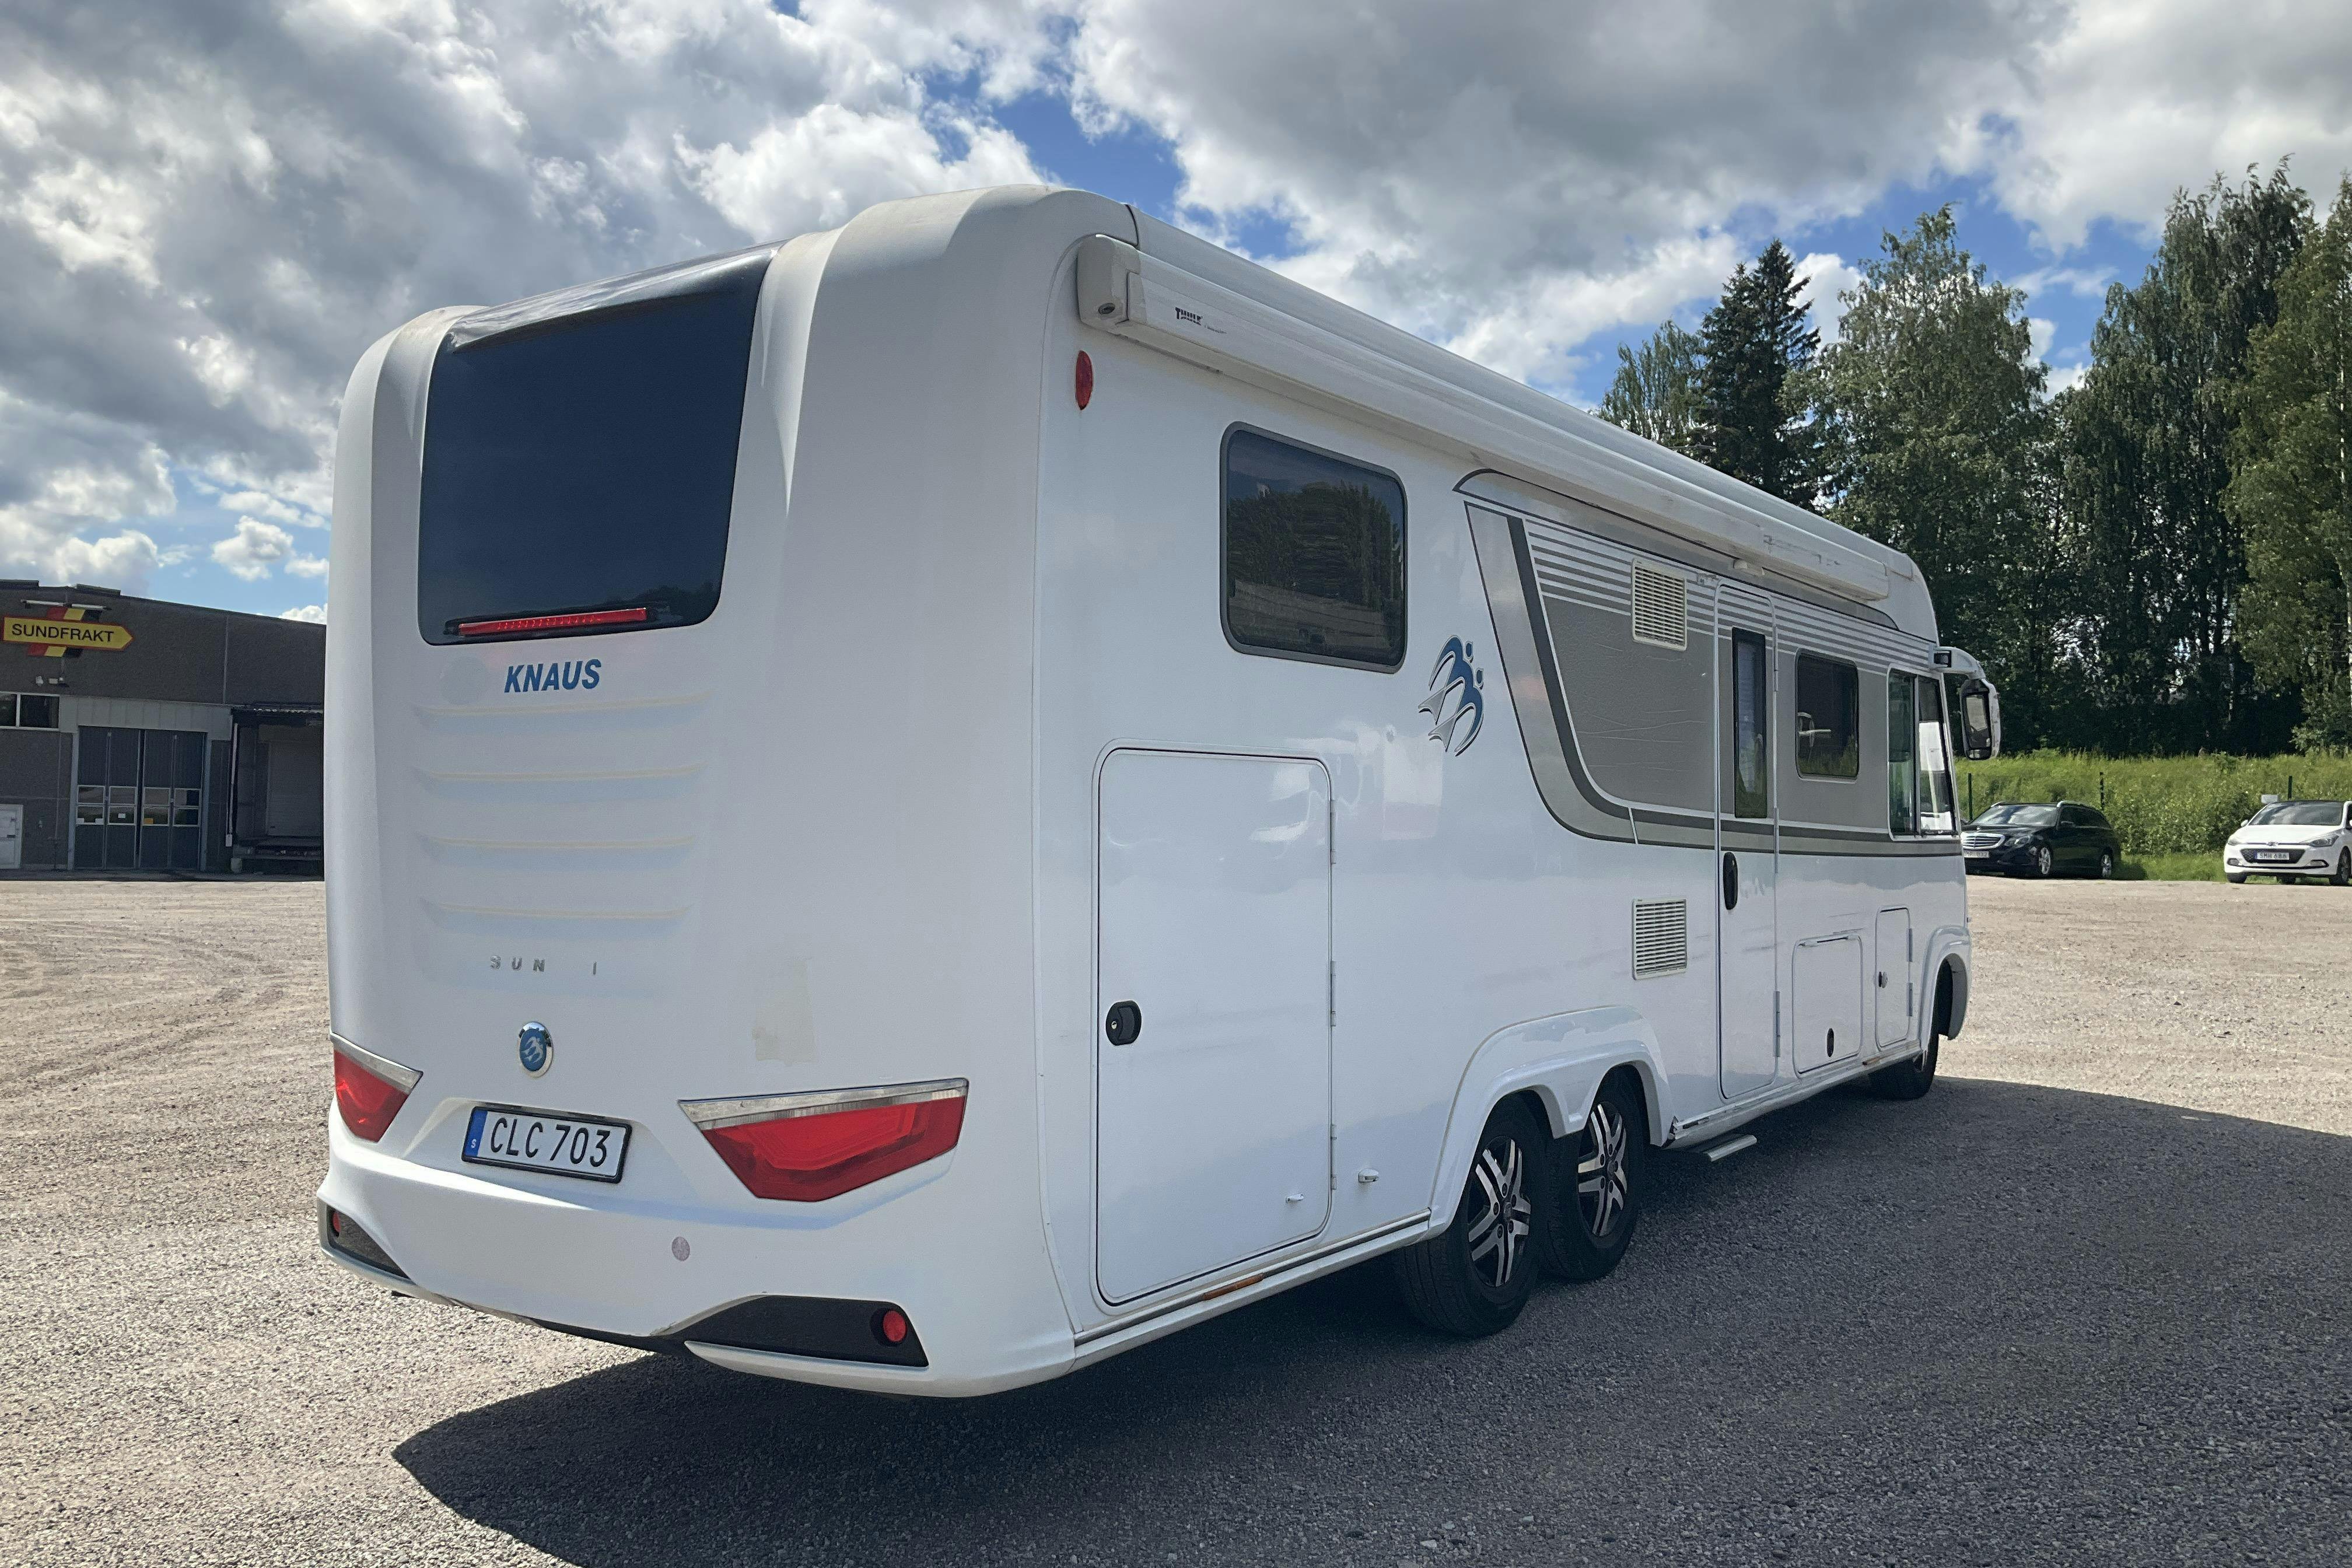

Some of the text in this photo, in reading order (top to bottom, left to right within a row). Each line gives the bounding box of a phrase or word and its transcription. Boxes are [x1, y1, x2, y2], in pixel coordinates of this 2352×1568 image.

[12, 624, 114, 642] SUNDFRAKT
[504, 659, 601, 693] KNAUS
[490, 955, 545, 972] SUN
[471, 1139, 477, 1149] S
[491, 1118, 611, 1167] CLC 703
